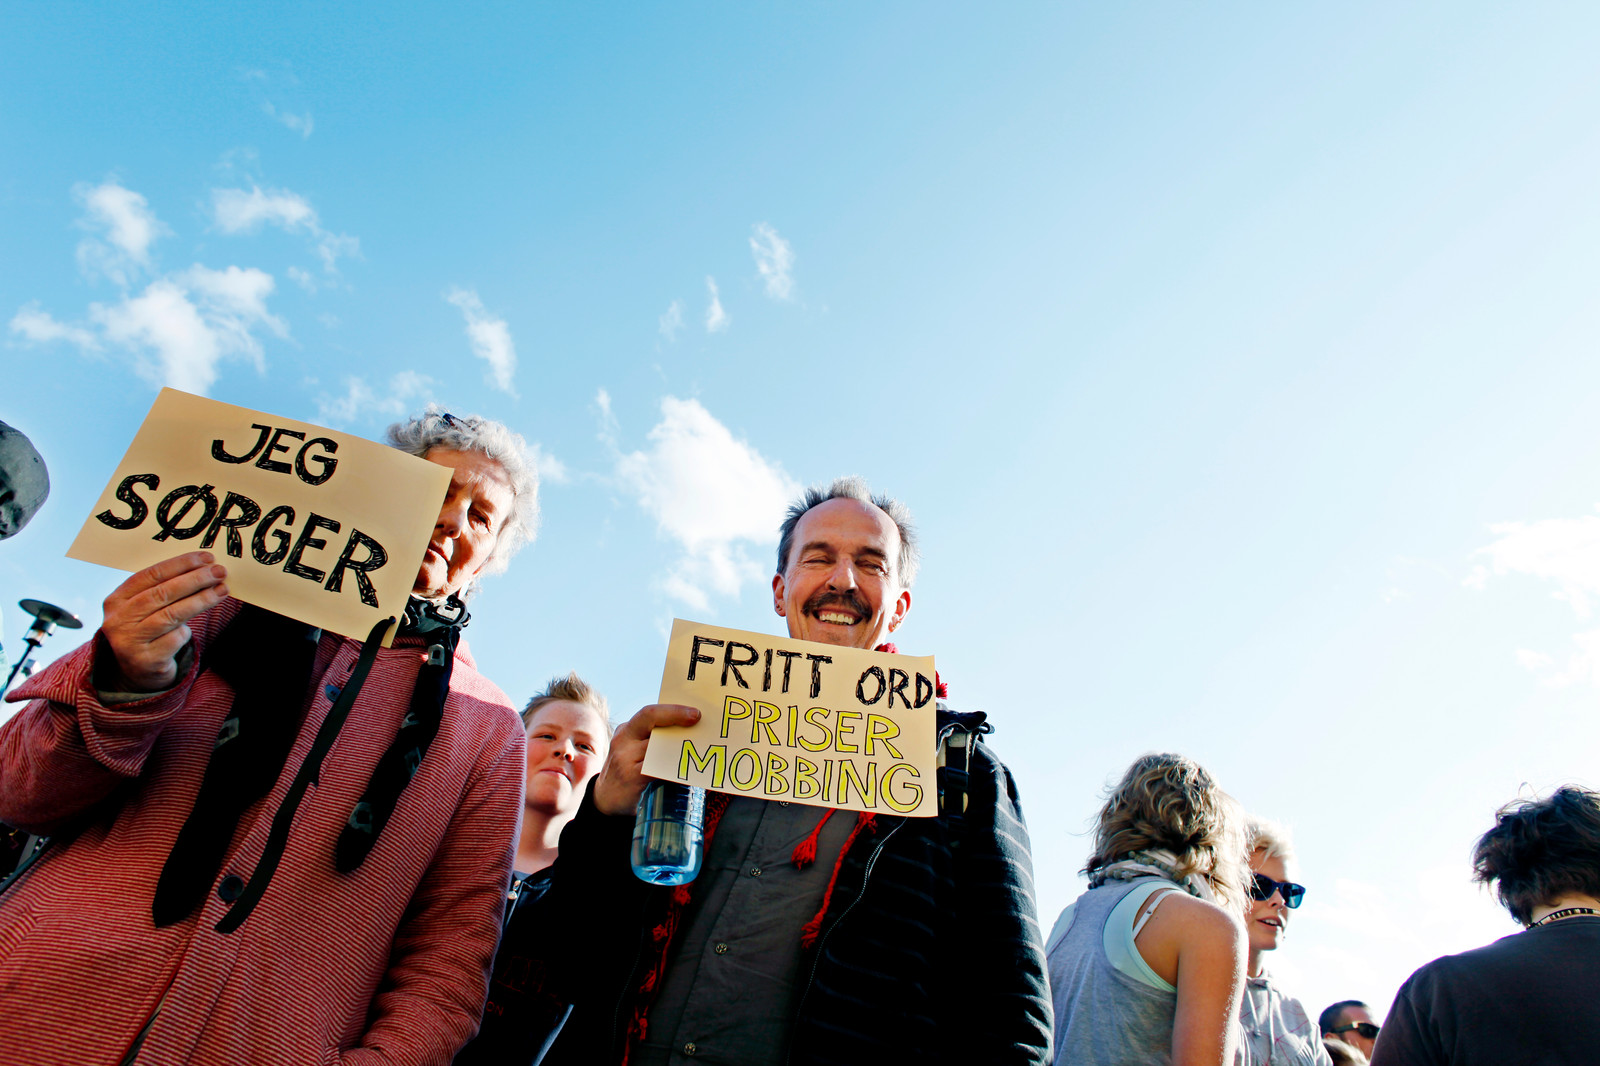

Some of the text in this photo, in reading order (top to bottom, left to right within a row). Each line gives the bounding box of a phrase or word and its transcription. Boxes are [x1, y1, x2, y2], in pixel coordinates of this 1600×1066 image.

[211, 423, 339, 486] JEG
[96, 473, 388, 609] SØRGER
[687, 635, 934, 710] FRITT ORD
[720, 695, 904, 760] PRISER
[677, 740, 924, 814] MOBBING
